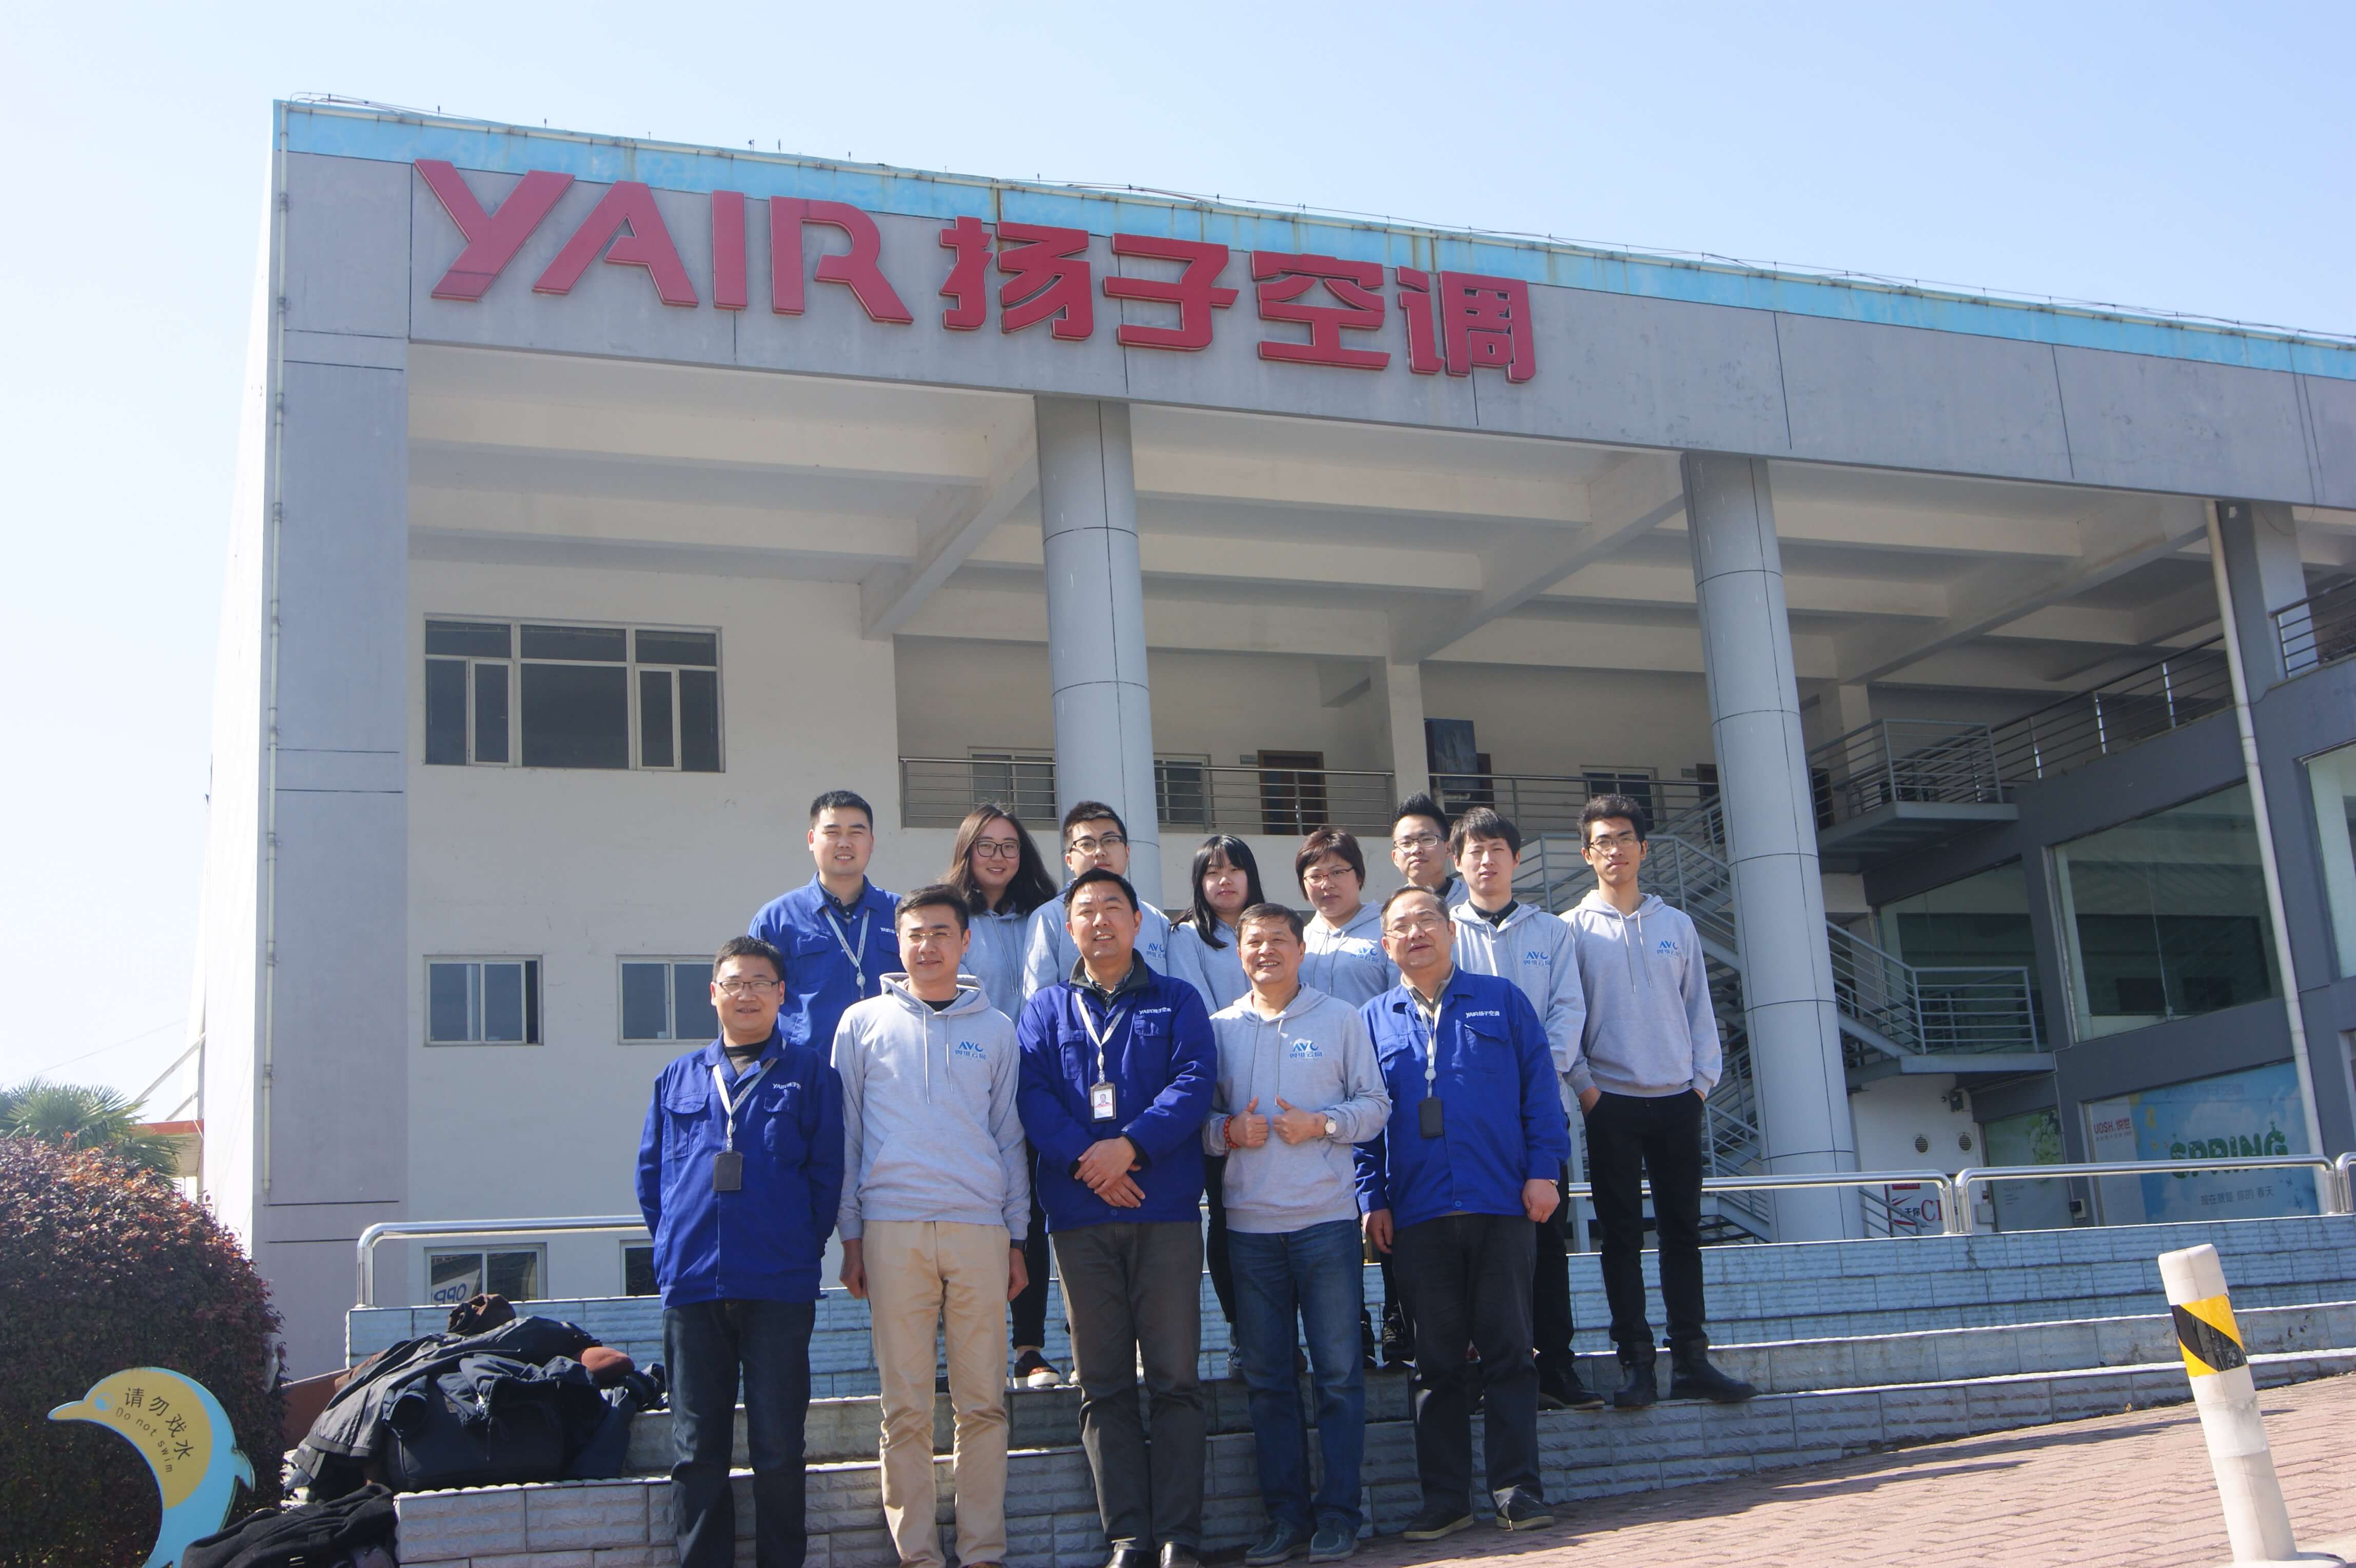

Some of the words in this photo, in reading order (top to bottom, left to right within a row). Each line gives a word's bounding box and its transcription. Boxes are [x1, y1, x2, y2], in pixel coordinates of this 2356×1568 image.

[414, 159, 914, 325] YAIR
[939, 215, 1537, 384] 扬子空调
[1659, 940, 1678, 950] AVC
[1526, 951, 1548, 959] AVC
[958, 1041, 984, 1052] AVC
[1293, 1042, 1319, 1052] AVC
[2093, 1121, 2114, 1134] UOSH
[2257, 1186, 2274, 1199] 春天
[125, 1387, 194, 1460] 请勿戏水
[115, 1407, 131, 1421] Do
[135, 1419, 158, 1437] not
[158, 1440, 173, 1473] swim
